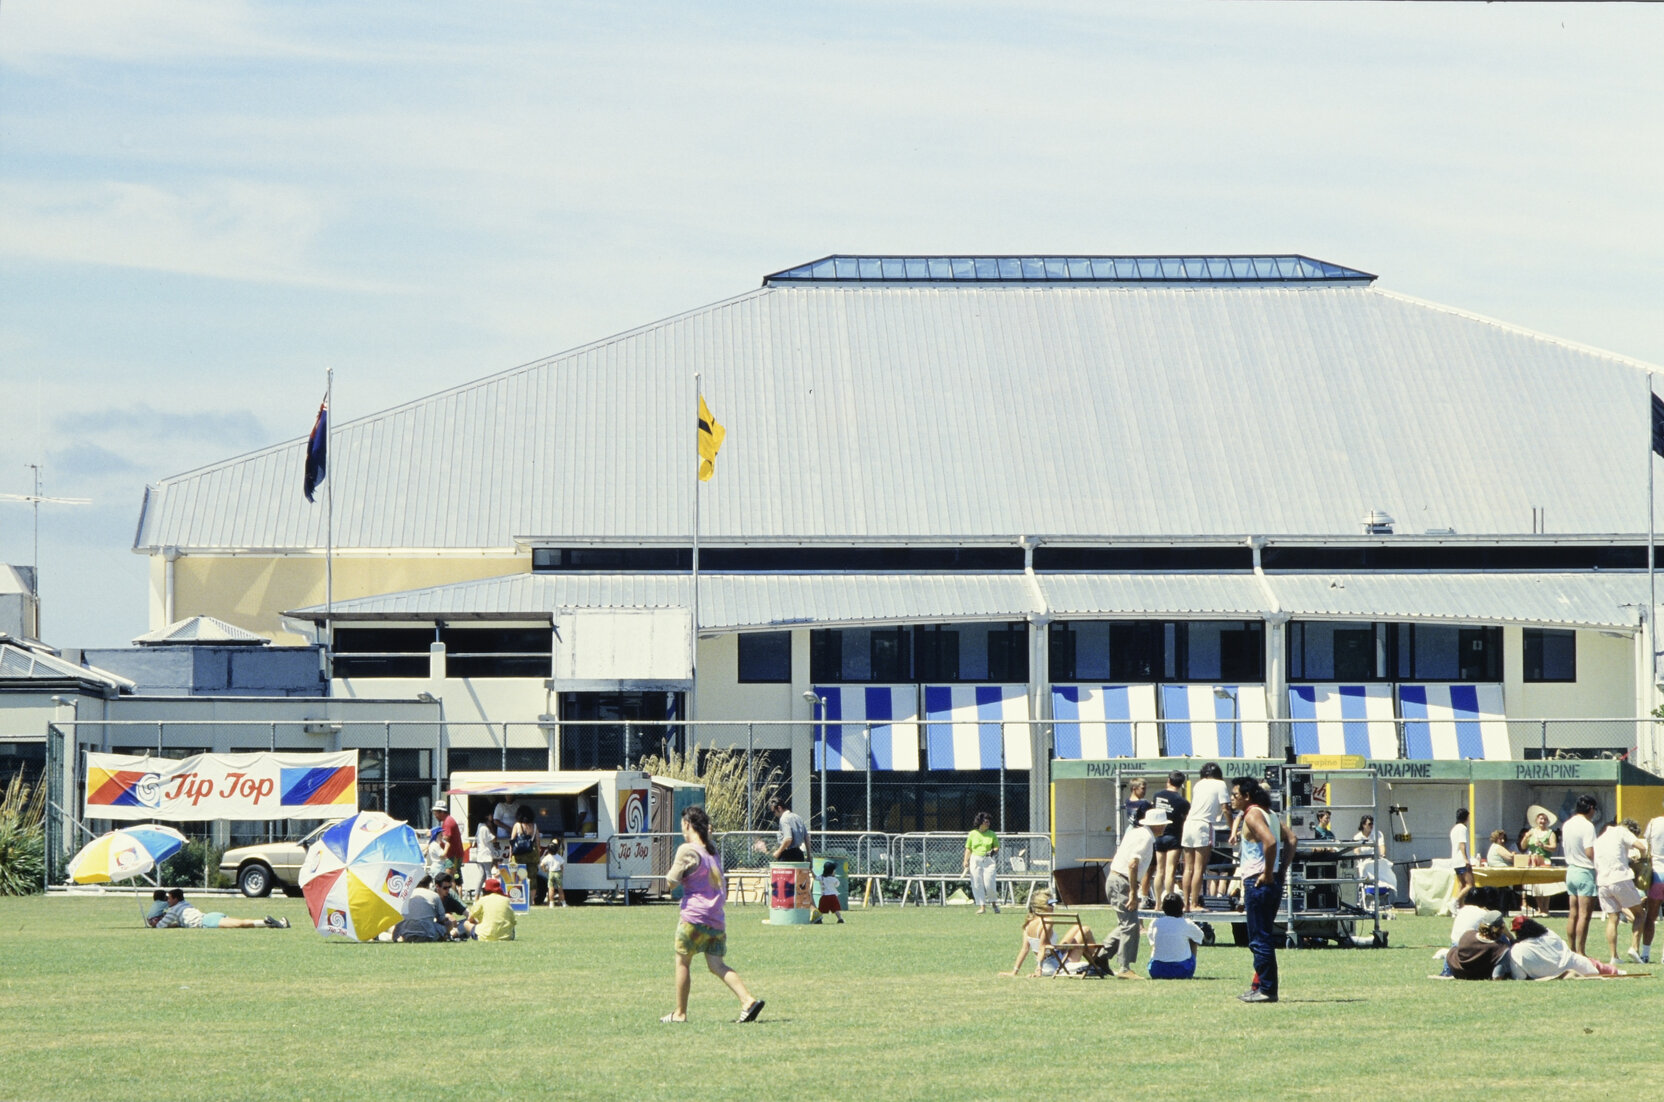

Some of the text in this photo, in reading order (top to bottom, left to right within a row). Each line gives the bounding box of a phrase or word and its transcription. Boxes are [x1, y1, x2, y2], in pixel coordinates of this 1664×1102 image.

[1368, 762, 1431, 778] PARAPINE
[1516, 764, 1581, 778] PARAPINE
[165, 772, 274, 806] Tip Top
[618, 842, 649, 860] Tip Top
